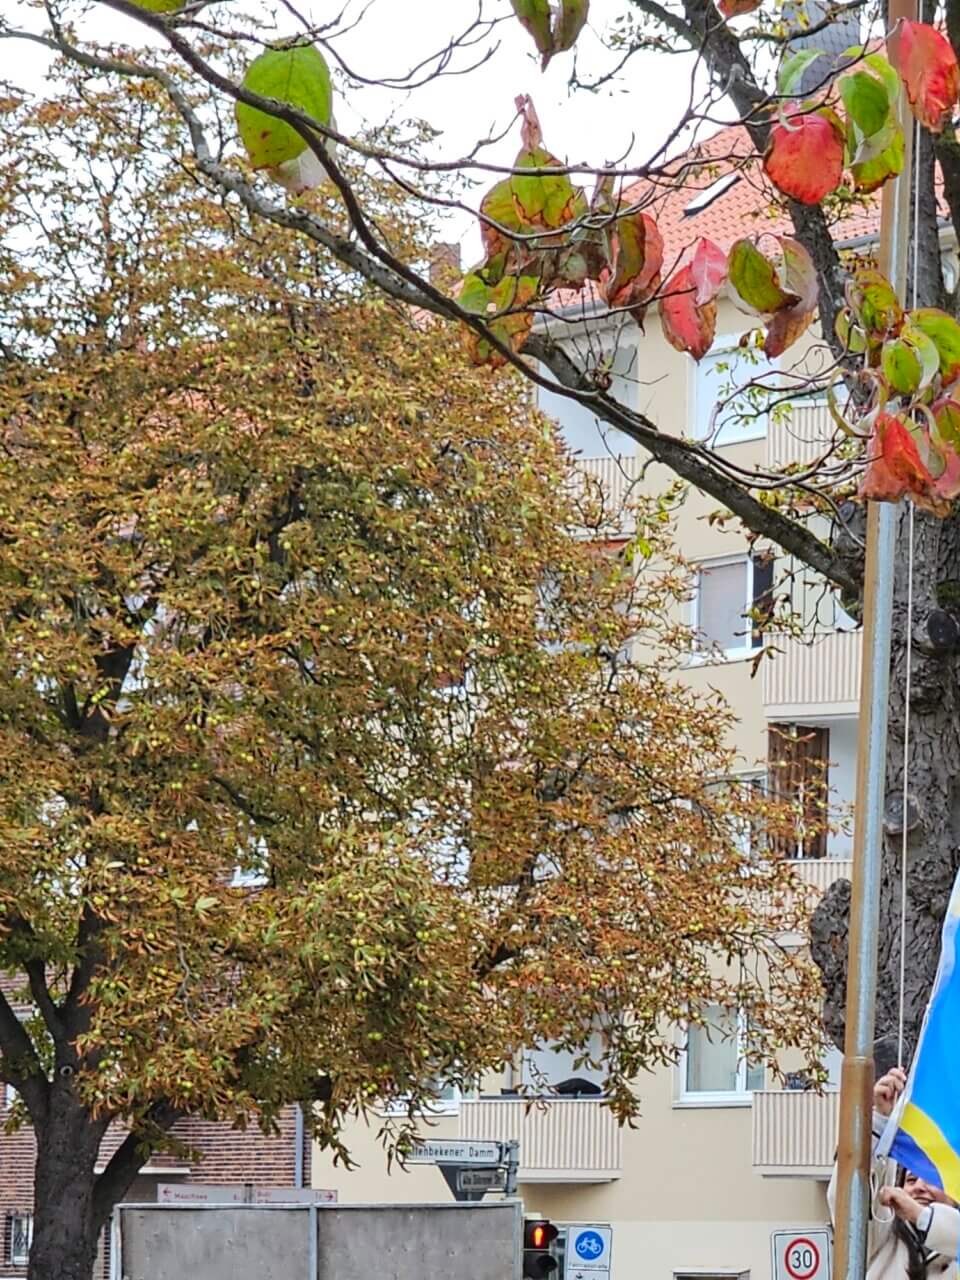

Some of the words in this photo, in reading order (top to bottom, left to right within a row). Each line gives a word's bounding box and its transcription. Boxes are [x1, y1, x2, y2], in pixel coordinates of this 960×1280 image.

[408, 1144, 464, 1158] tenbekener
[469, 1146, 495, 1158] Damm
[791, 1249, 813, 1269] 30
